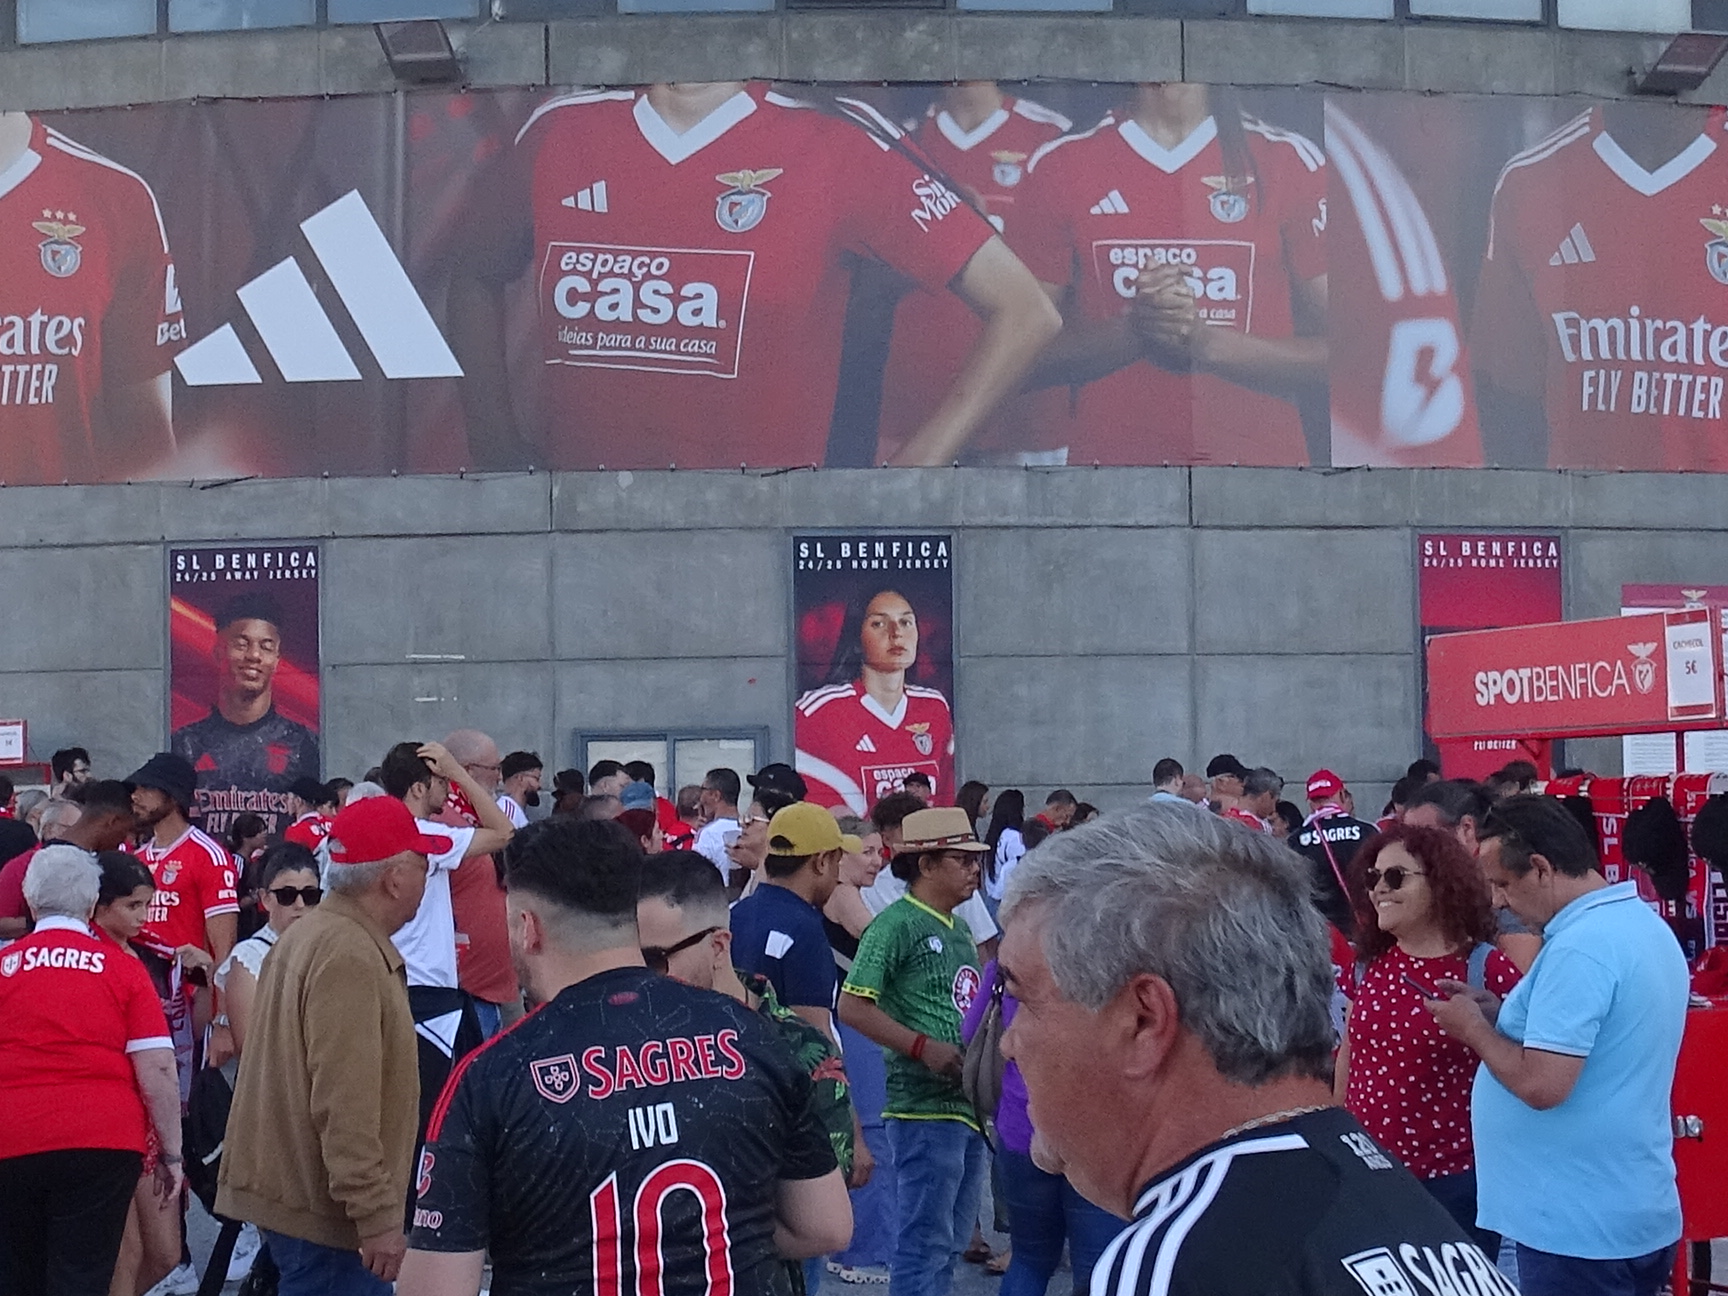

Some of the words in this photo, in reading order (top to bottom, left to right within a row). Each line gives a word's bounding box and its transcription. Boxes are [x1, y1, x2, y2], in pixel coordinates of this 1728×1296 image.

[559, 251, 671, 279] espaço
[553, 275, 718, 328] casa
[597, 331, 631, 351] para
[635, 337, 646, 348] a
[648, 337, 676, 352] sua
[679, 339, 717, 355] casa
[1581, 369, 1621, 413] FLY
[1629, 370, 1725, 420] BETTER
[176, 553, 200, 571] SL
[215, 551, 316, 570] BENFICA
[799, 542, 824, 558] SL
[841, 541, 948, 558] BENFICA
[1424, 541, 1447, 557] SL
[1462, 540, 1558, 557] BENFICA
[852, 559, 889, 570] HOME
[898, 558, 948, 569] JERSEY
[1684, 660, 1698, 675] 5€
[1474, 659, 1631, 706] SPOTBENFICA
[1312, 825, 1361, 846] SAGRES
[1602, 816, 1619, 855] SL
[22, 946, 106, 974] SAGRES
[581, 1029, 746, 1099] SAGRES
[628, 1103, 678, 1151] IVO
